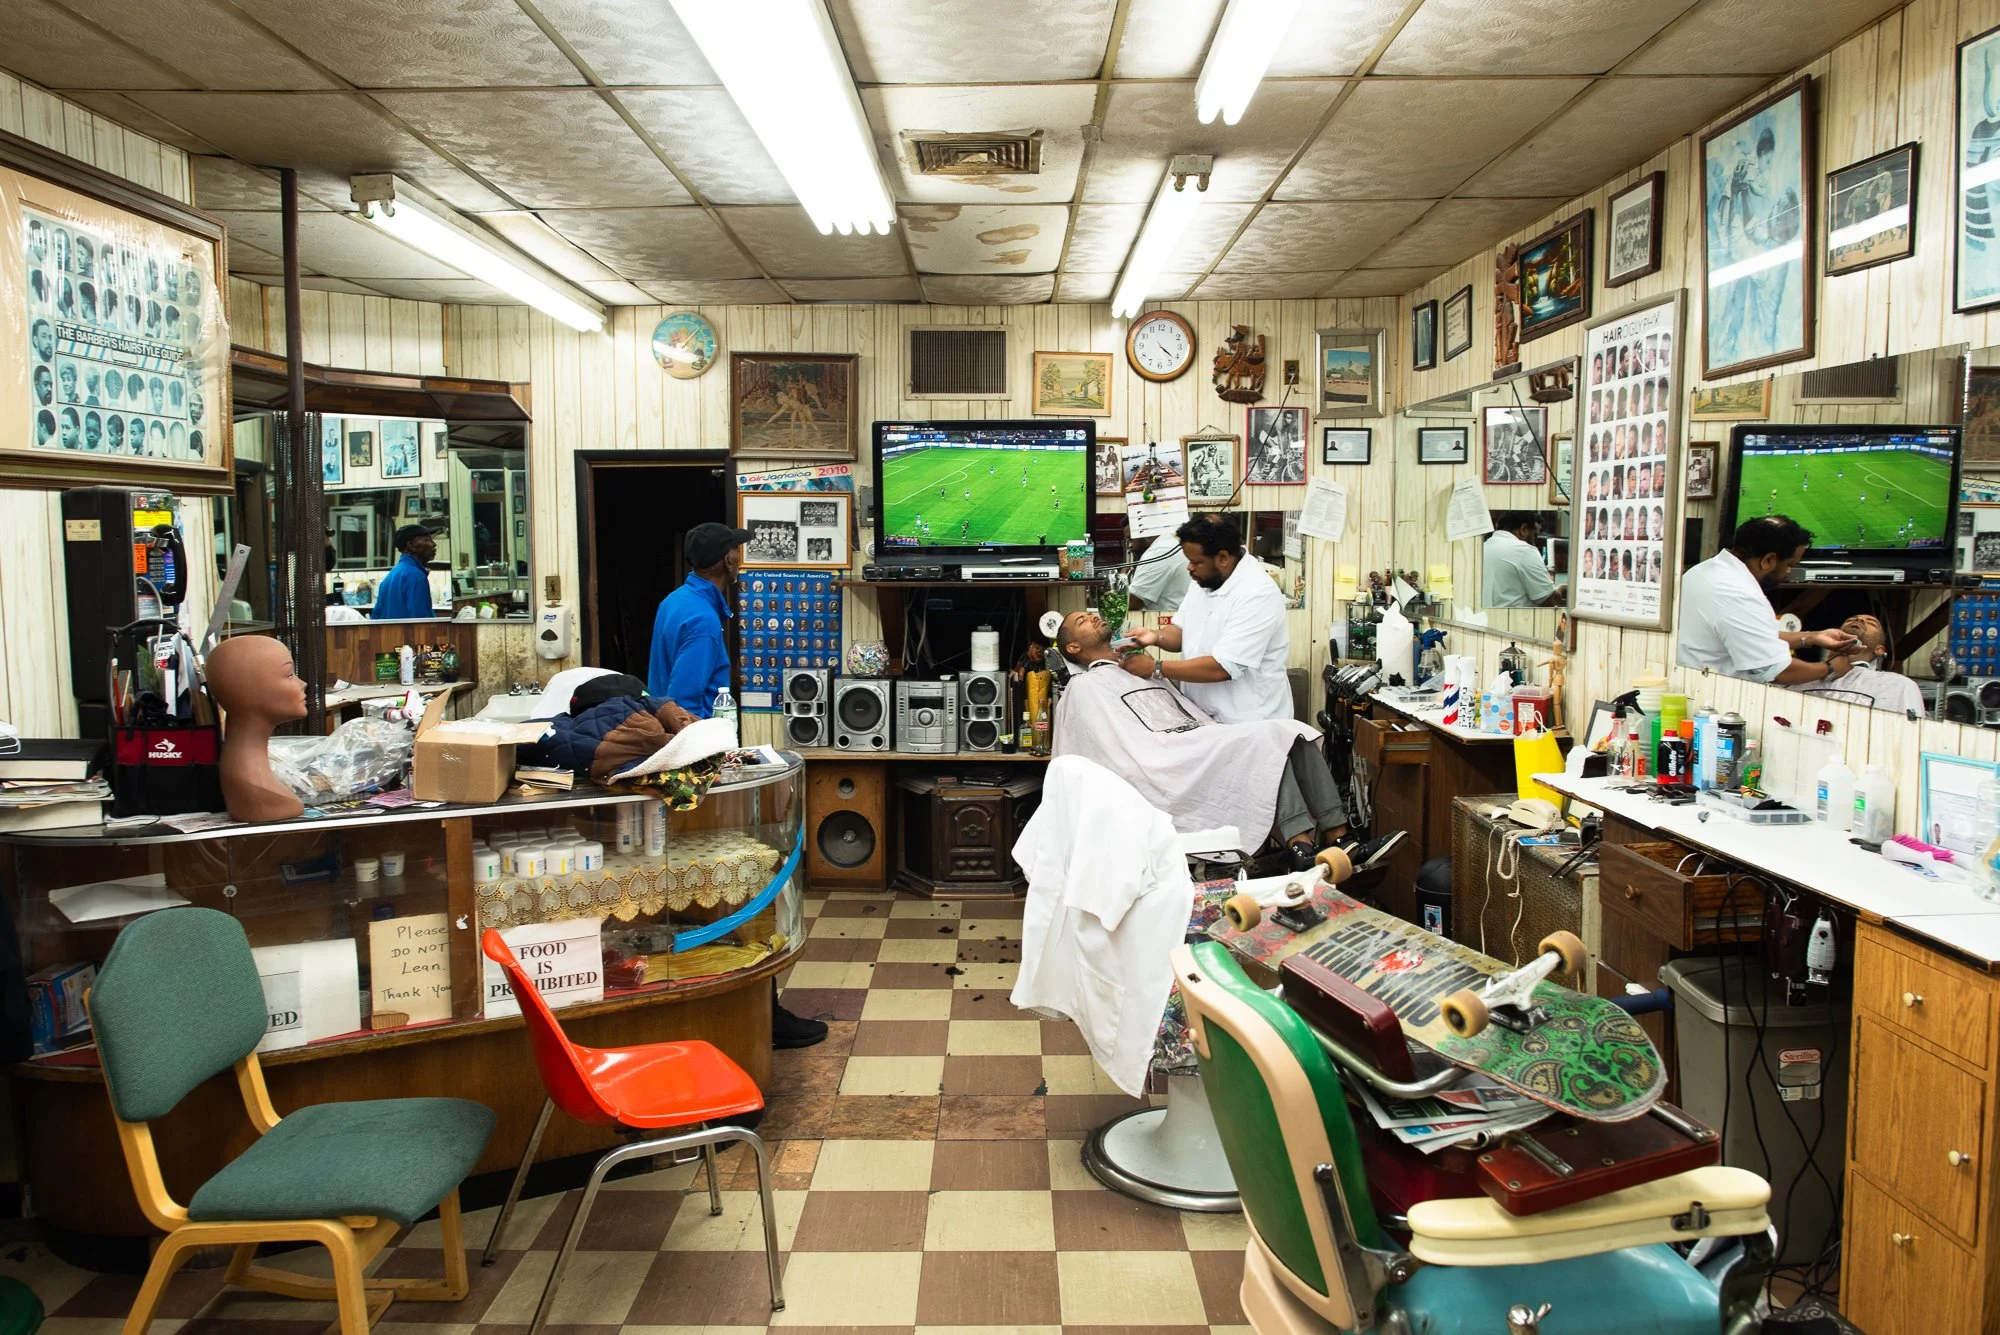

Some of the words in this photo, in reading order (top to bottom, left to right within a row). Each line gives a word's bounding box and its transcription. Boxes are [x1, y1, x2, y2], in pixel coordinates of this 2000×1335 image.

[57, 326, 75, 340] THE
[818, 466, 848, 476] 2010
[1669, 750, 1677, 777] Gillette
[397, 926, 448, 939] Please
[391, 947, 410, 958] DO
[418, 943, 448, 953] NOT
[520, 942, 567, 960] FOOD
[537, 960, 553, 974] IS
[381, 987, 421, 1002] Thank
